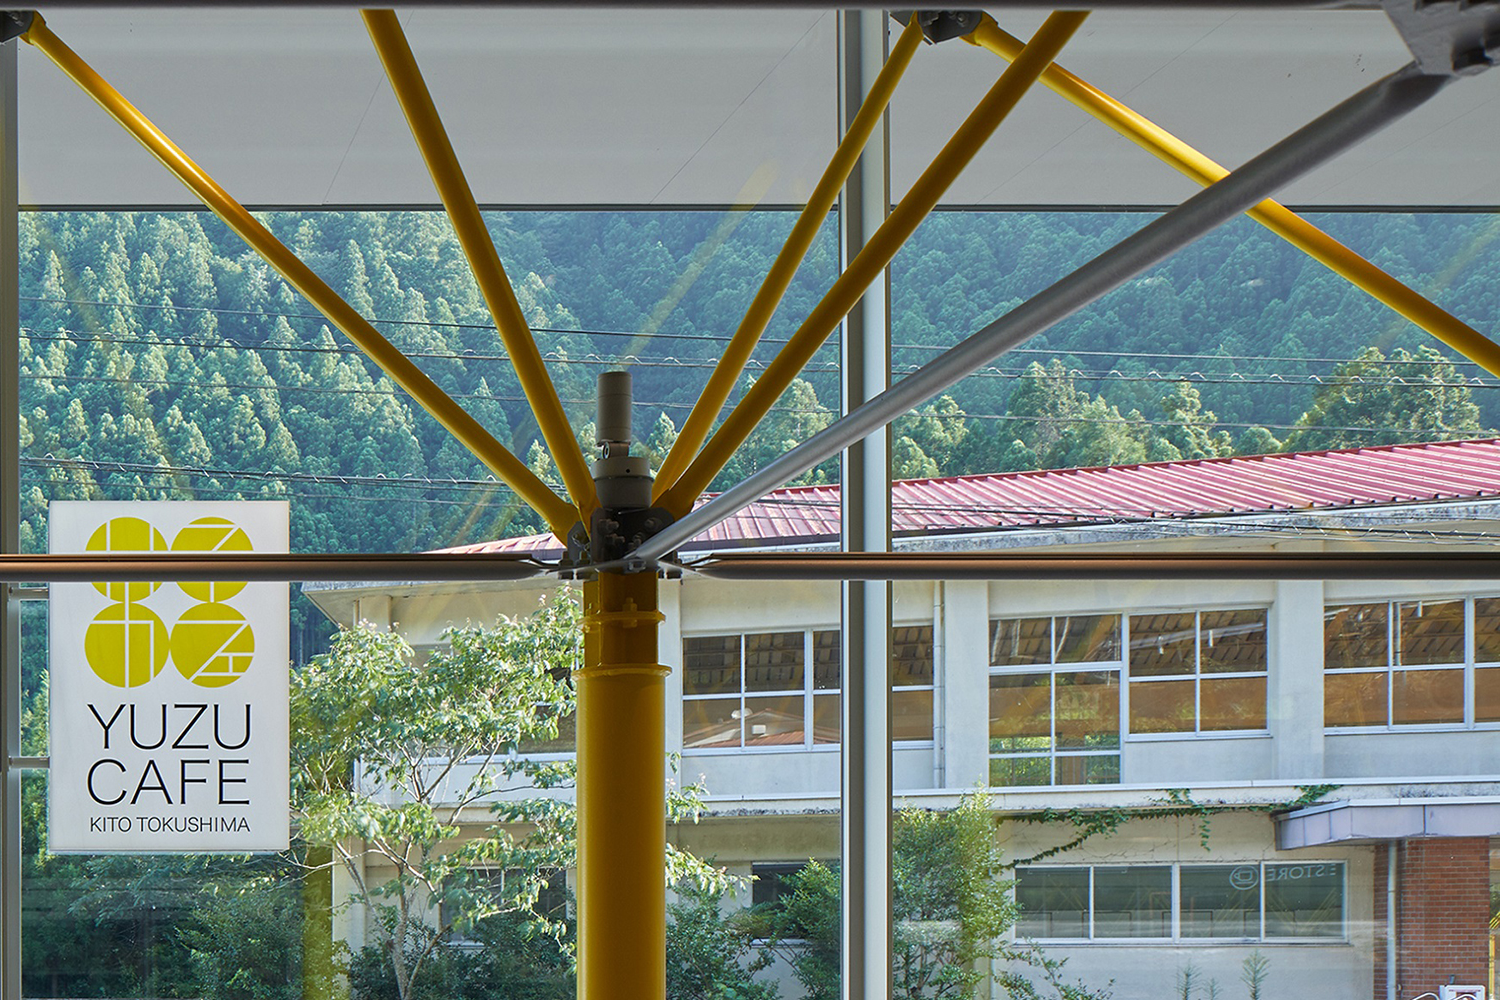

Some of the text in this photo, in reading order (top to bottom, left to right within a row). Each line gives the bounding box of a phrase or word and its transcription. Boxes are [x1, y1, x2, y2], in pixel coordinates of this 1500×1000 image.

[87, 703, 252, 750] YUZU
[87, 758, 250, 806] CAFE
[90, 817, 251, 833] KITO TOKUSHIMA
